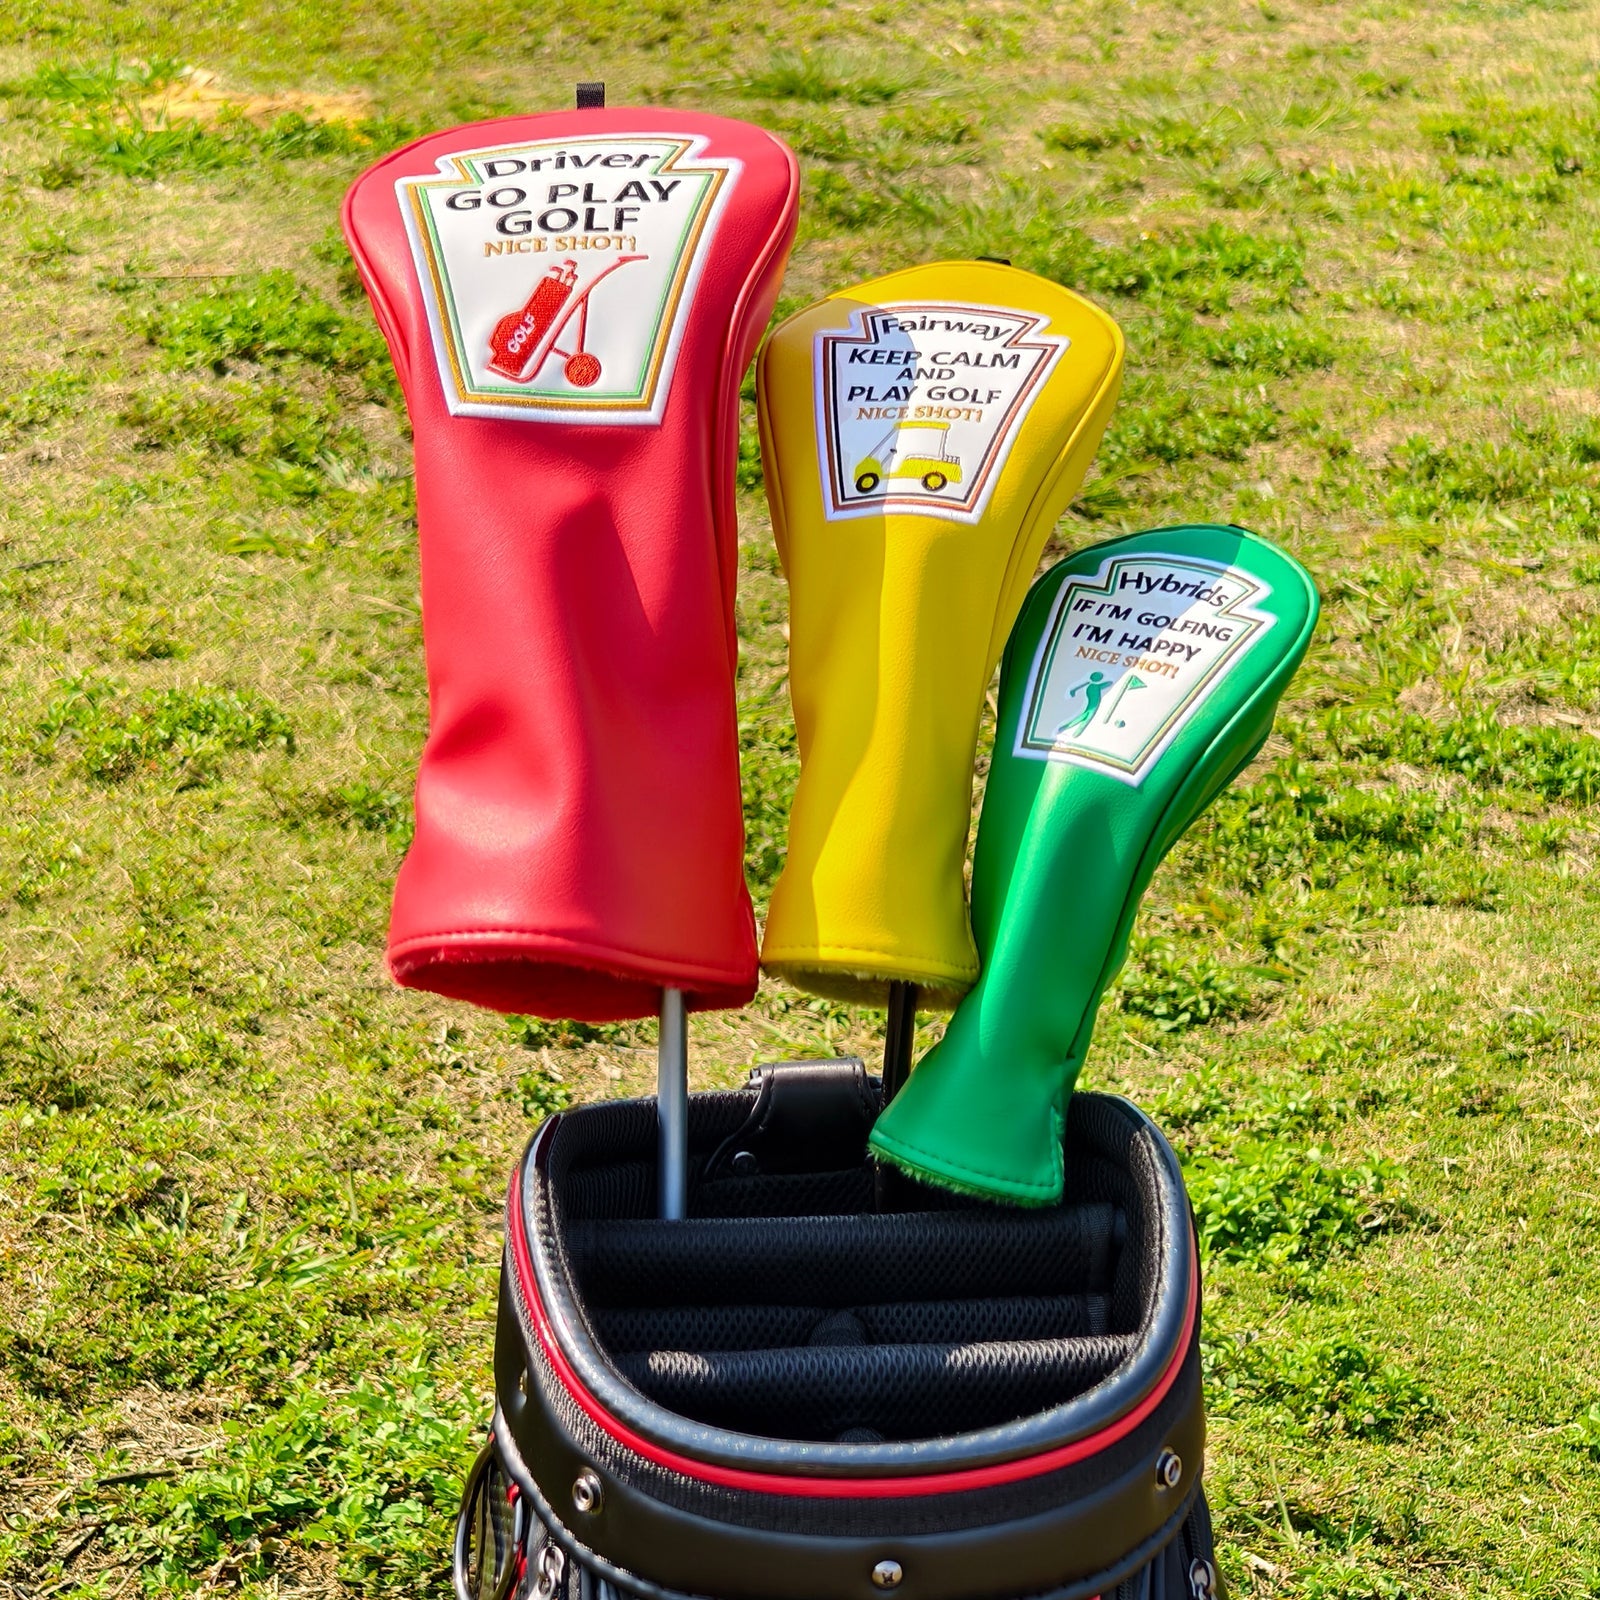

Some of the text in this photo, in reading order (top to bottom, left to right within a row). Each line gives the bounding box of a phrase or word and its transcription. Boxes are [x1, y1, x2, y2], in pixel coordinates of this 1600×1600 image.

[484, 151, 660, 178] Driver
[446, 180, 682, 210] GO PLAY
[496, 207, 640, 235] GOLF
[484, 236, 548, 257] NICE
[507, 313, 536, 353] GOLF
[881, 316, 1012, 341] Fairway
[848, 348, 1021, 369] KEEP CALM
[895, 368, 956, 381] AND
[847, 386, 1001, 405] PLAY GOLF
[856, 406, 909, 420] NICE
[1118, 571, 1229, 607] Hybrids
[1072, 598, 1234, 642] IF I'M GOLFING
[1072, 623, 1202, 662] I'M HAPPY
[1075, 646, 1180, 680] NICE SHOT!
